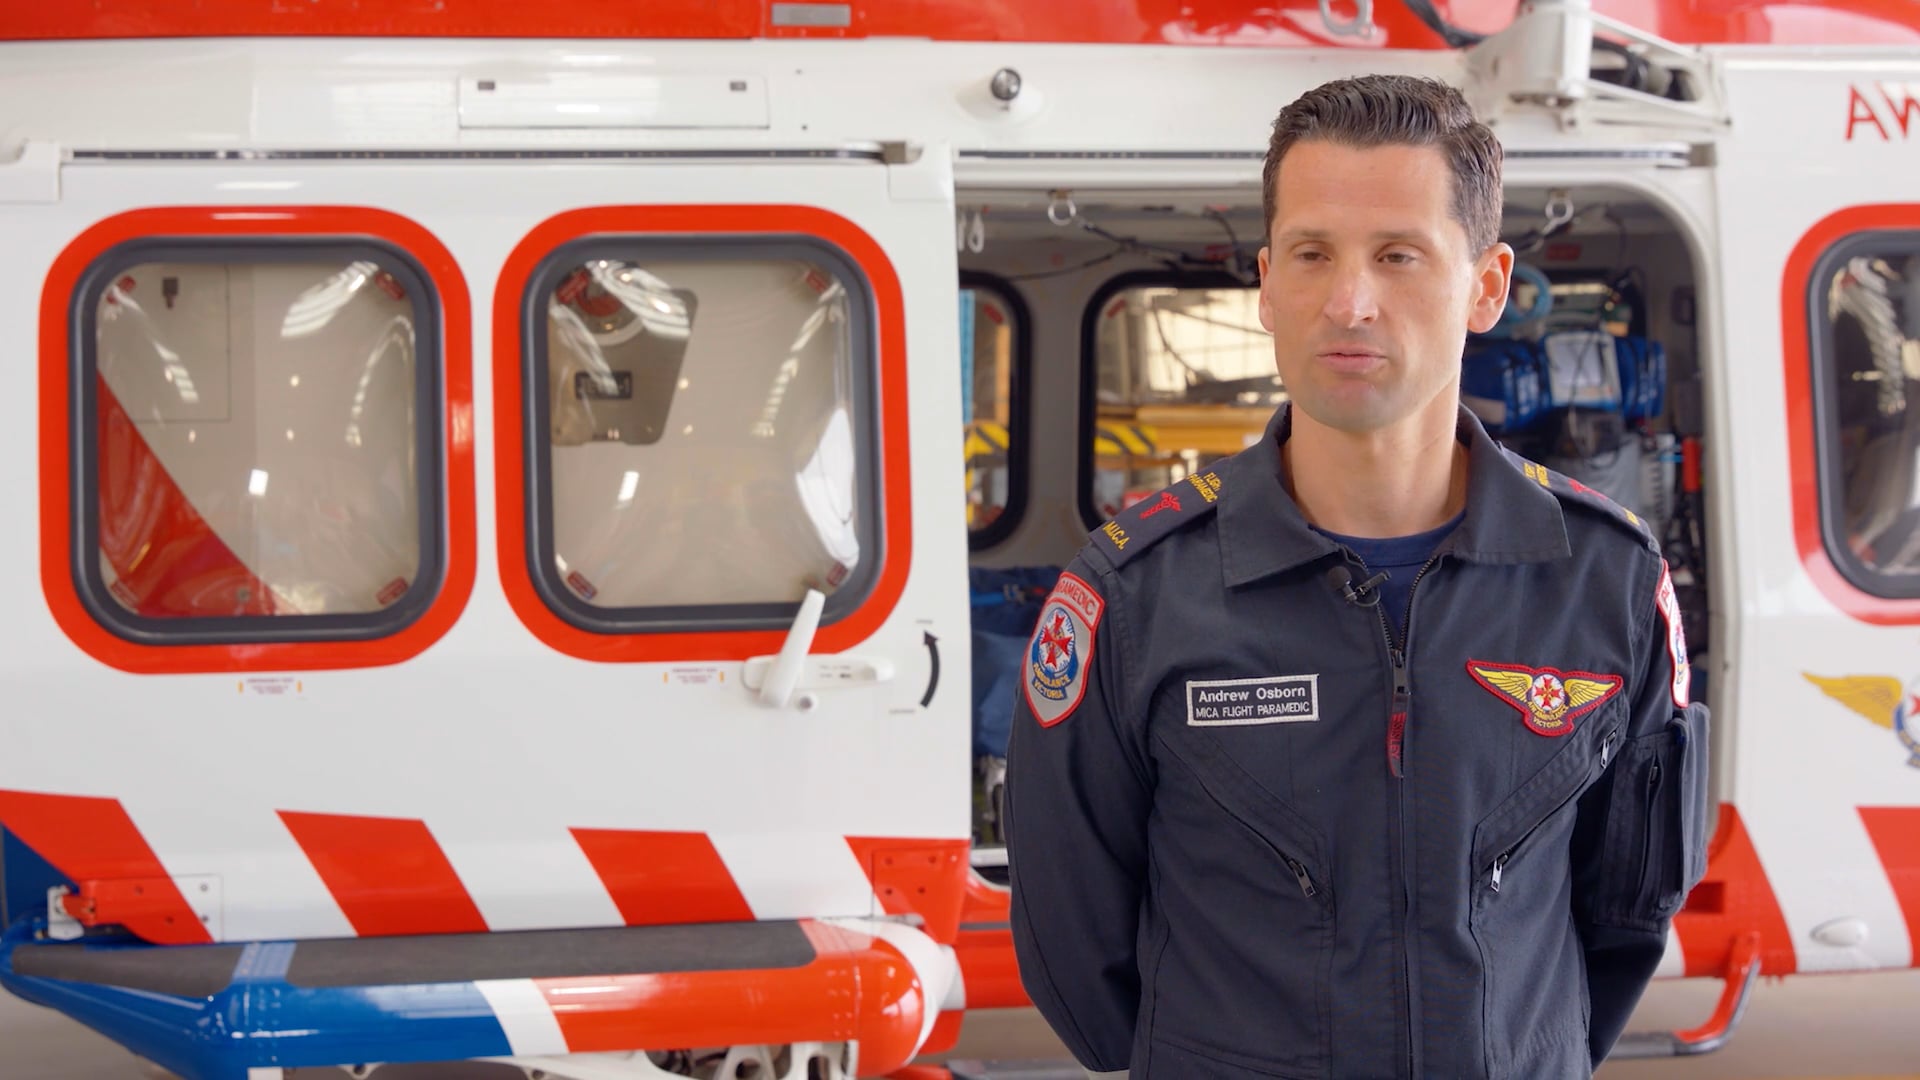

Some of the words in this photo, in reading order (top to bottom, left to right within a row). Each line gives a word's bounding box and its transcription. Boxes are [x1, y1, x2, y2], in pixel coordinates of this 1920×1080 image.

[1034, 679, 1064, 699] VICTORIA
[1198, 690, 1250, 703] Andrew
[1256, 687, 1305, 700] Osborn
[1196, 707, 1219, 718] MICA
[1222, 705, 1254, 717] FLIGHT
[1257, 701, 1310, 715] PARAMEDIC
[1533, 716, 1563, 728] VICTORIA
